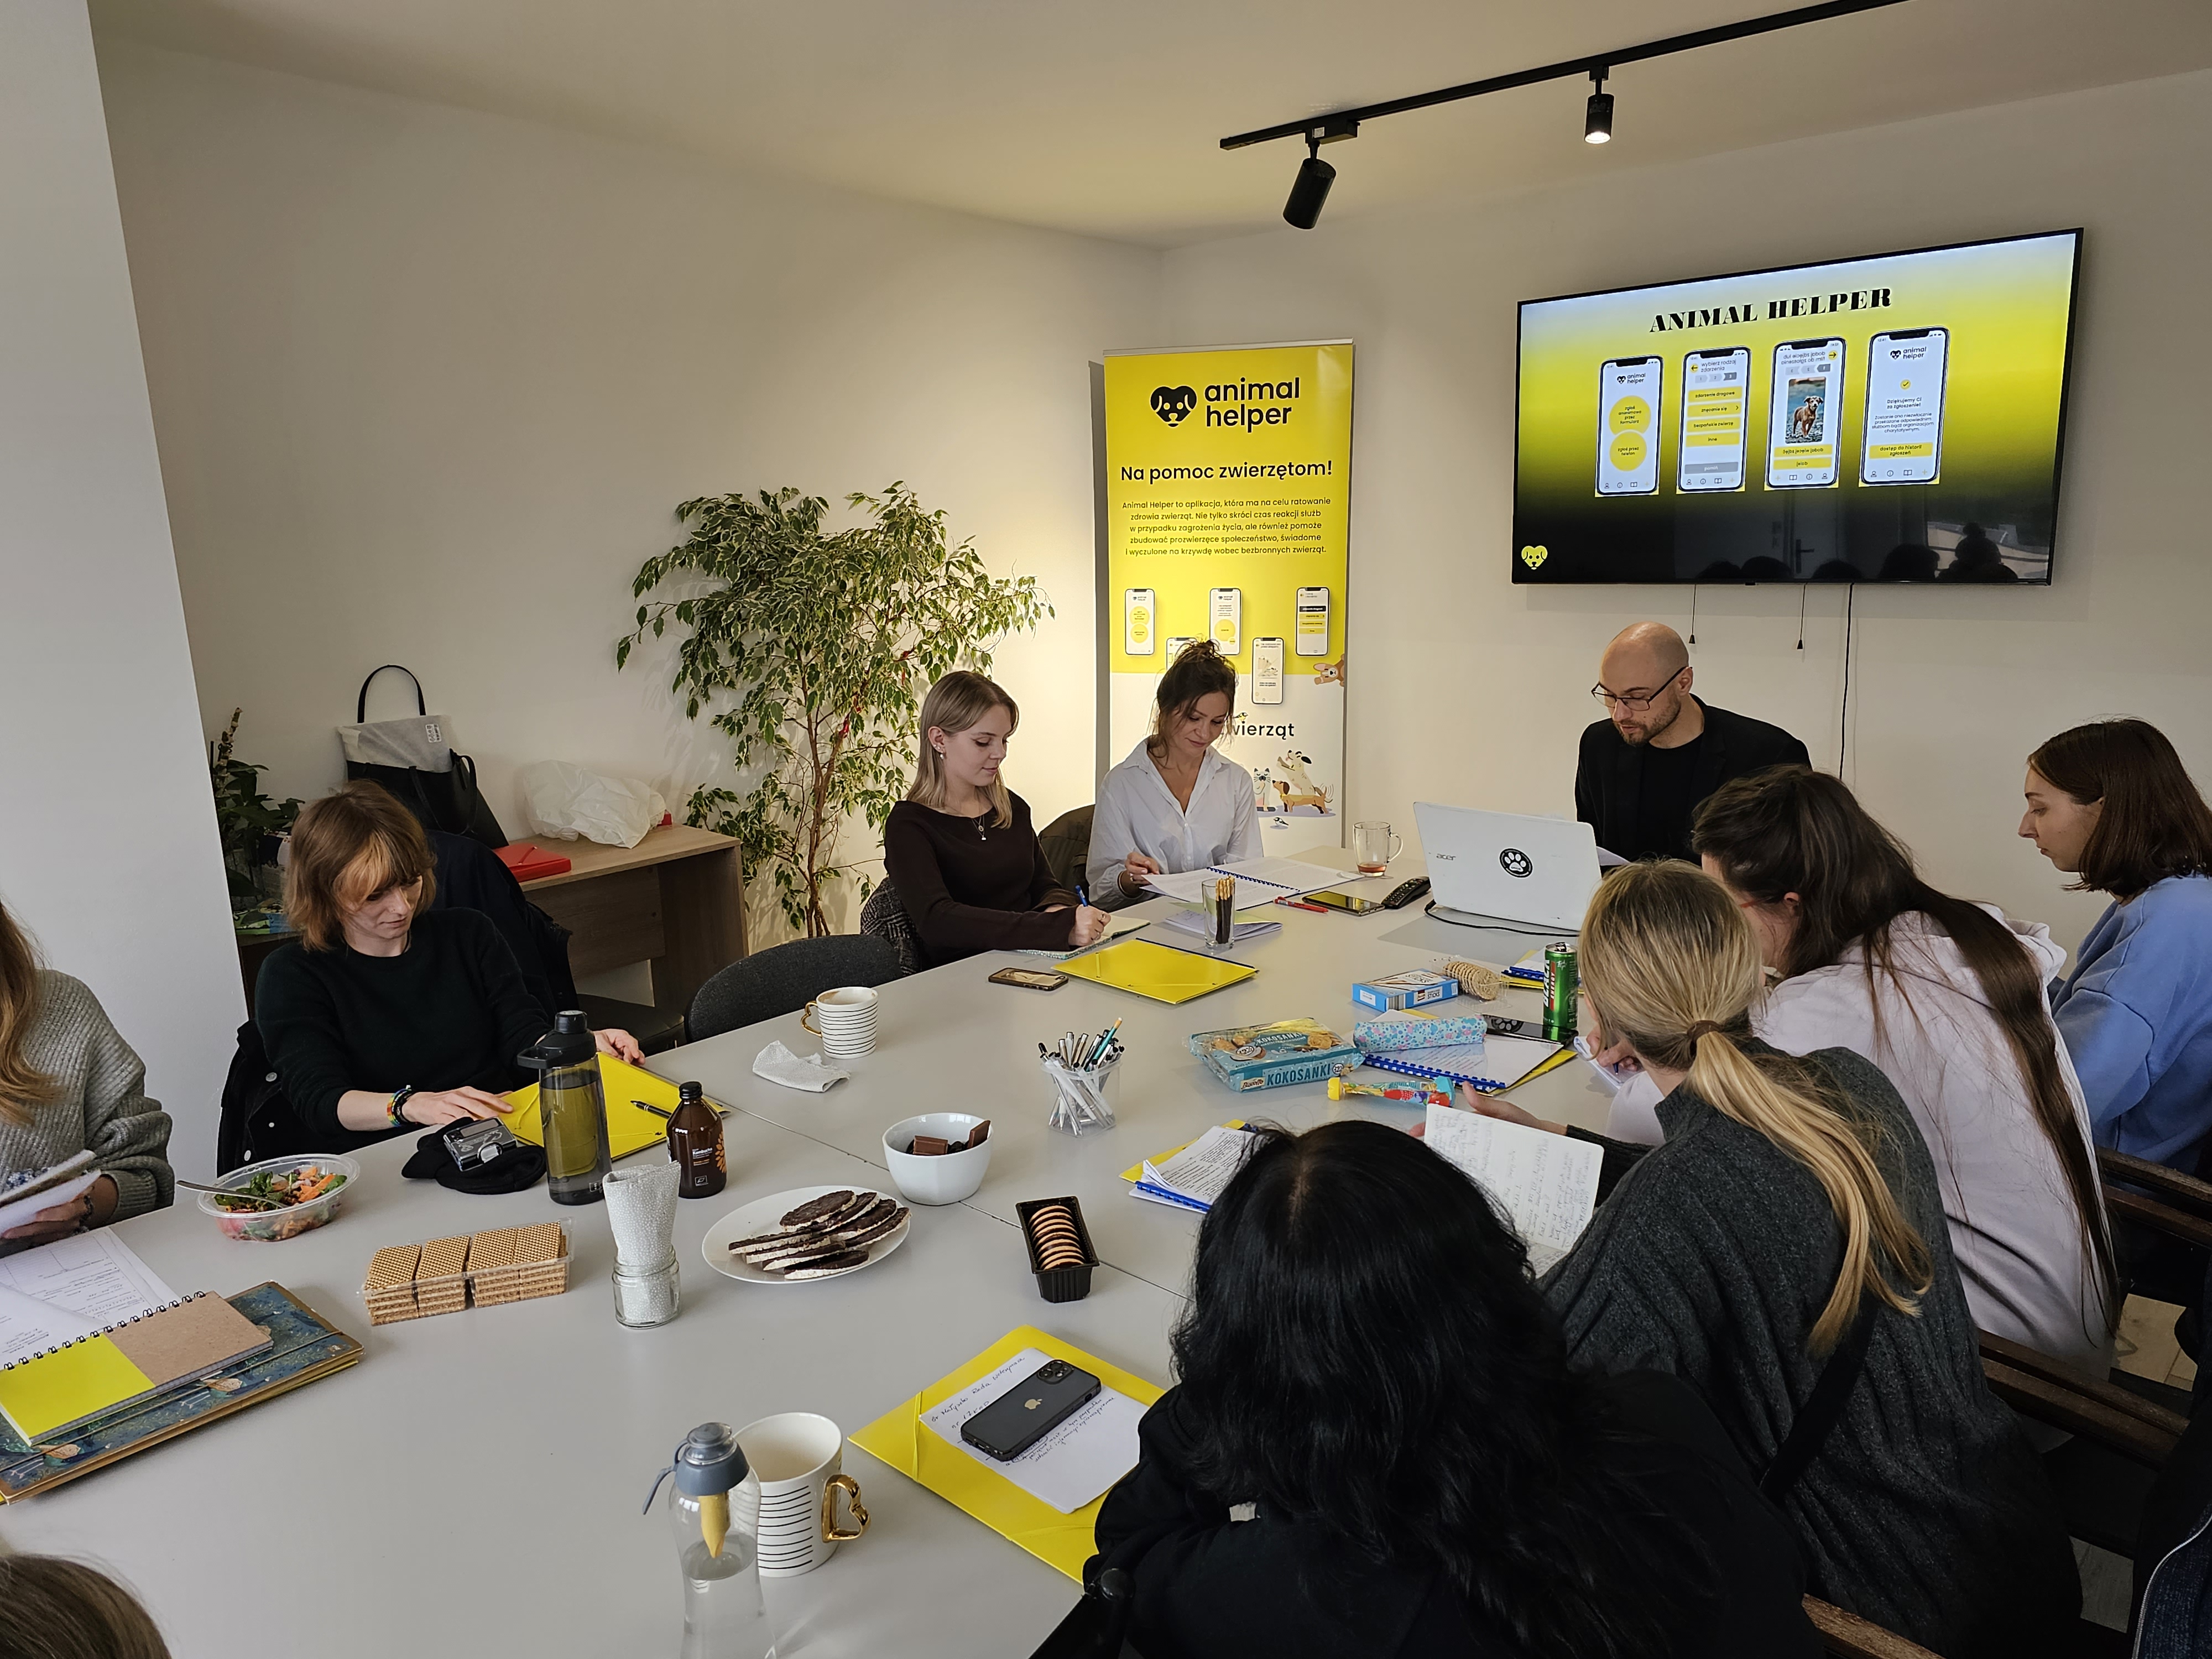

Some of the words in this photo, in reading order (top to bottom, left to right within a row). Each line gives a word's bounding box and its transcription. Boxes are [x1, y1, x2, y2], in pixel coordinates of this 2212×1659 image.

[1649, 304, 1757, 332] ANIMAL
[1767, 288, 1891, 320] HELPER
[1204, 377, 1300, 402] animal
[1206, 404, 1292, 433] helper
[1121, 466, 1144, 481] Na
[1150, 467, 1214, 484] pomoc
[1219, 461, 1332, 480] zwierzętom!
[1150, 501, 1174, 510] Helper
[1185, 499, 1223, 510] aplikacja,
[1224, 499, 1244, 507] która
[1291, 497, 1331, 505] ratowanie
[1161, 512, 1194, 521] zwierząt.
[1209, 512, 1228, 521] tylko
[1229, 510, 1252, 519] skróci
[1273, 509, 1299, 519] reakcji
[1138, 524, 1177, 534] przypadku
[1178, 523, 1220, 533] zagrożenia
[1222, 523, 1244, 533] życia,
[1290, 521, 1322, 531] pomoże
[1170, 535, 1219, 545] prozwierzęce
[1280, 533, 1322, 541] świadome
[1129, 548, 1167, 557] wyczulone
[1181, 547, 1212, 556] krzywdę
[1241, 546, 1291, 555] bezbronnych
[1292, 545, 1327, 554] zwierząt.
[1226, 721, 1295, 740] wierząt
[1256, 1032, 1302, 1044] KOKOSANKI
[1266, 1065, 1331, 1086] KOKOSANKI
